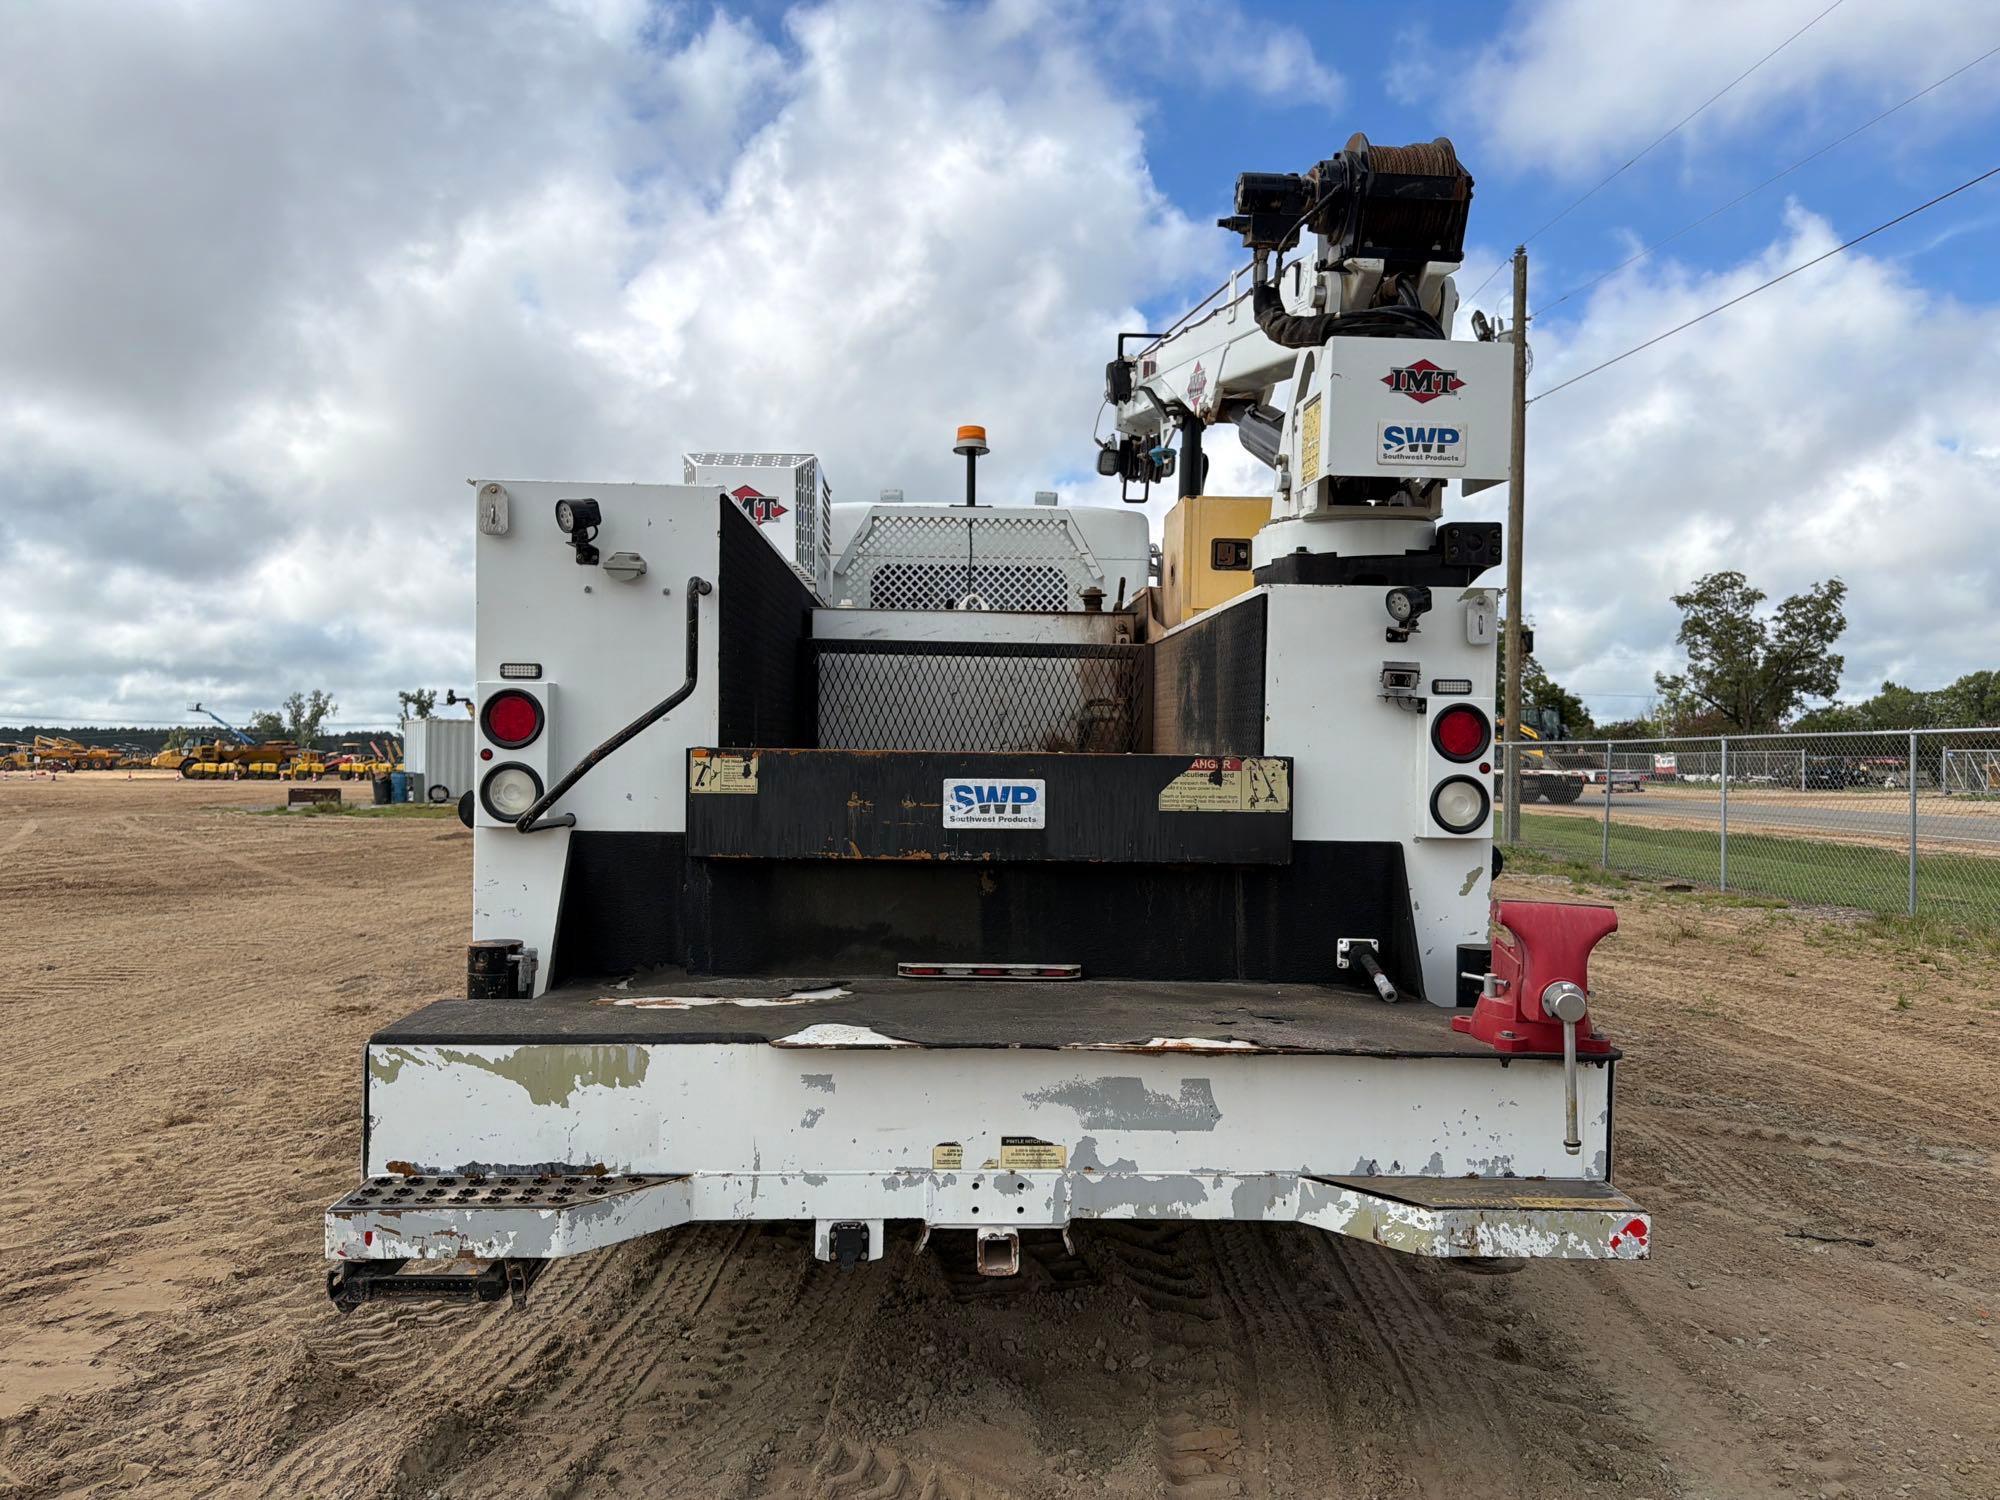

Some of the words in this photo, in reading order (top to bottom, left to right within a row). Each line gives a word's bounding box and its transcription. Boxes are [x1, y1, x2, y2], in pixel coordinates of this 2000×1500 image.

[1391, 369, 1457, 395] IMT
[1383, 425, 1460, 453] SWP
[1382, 453, 1423, 461] Southwest
[1425, 454, 1459, 462] Products
[736, 497, 778, 522] MT
[1191, 759, 1231, 769] ANGR
[949, 784, 1037, 815] SWP
[949, 815, 996, 823] Southwest
[998, 815, 1037, 823] Products
